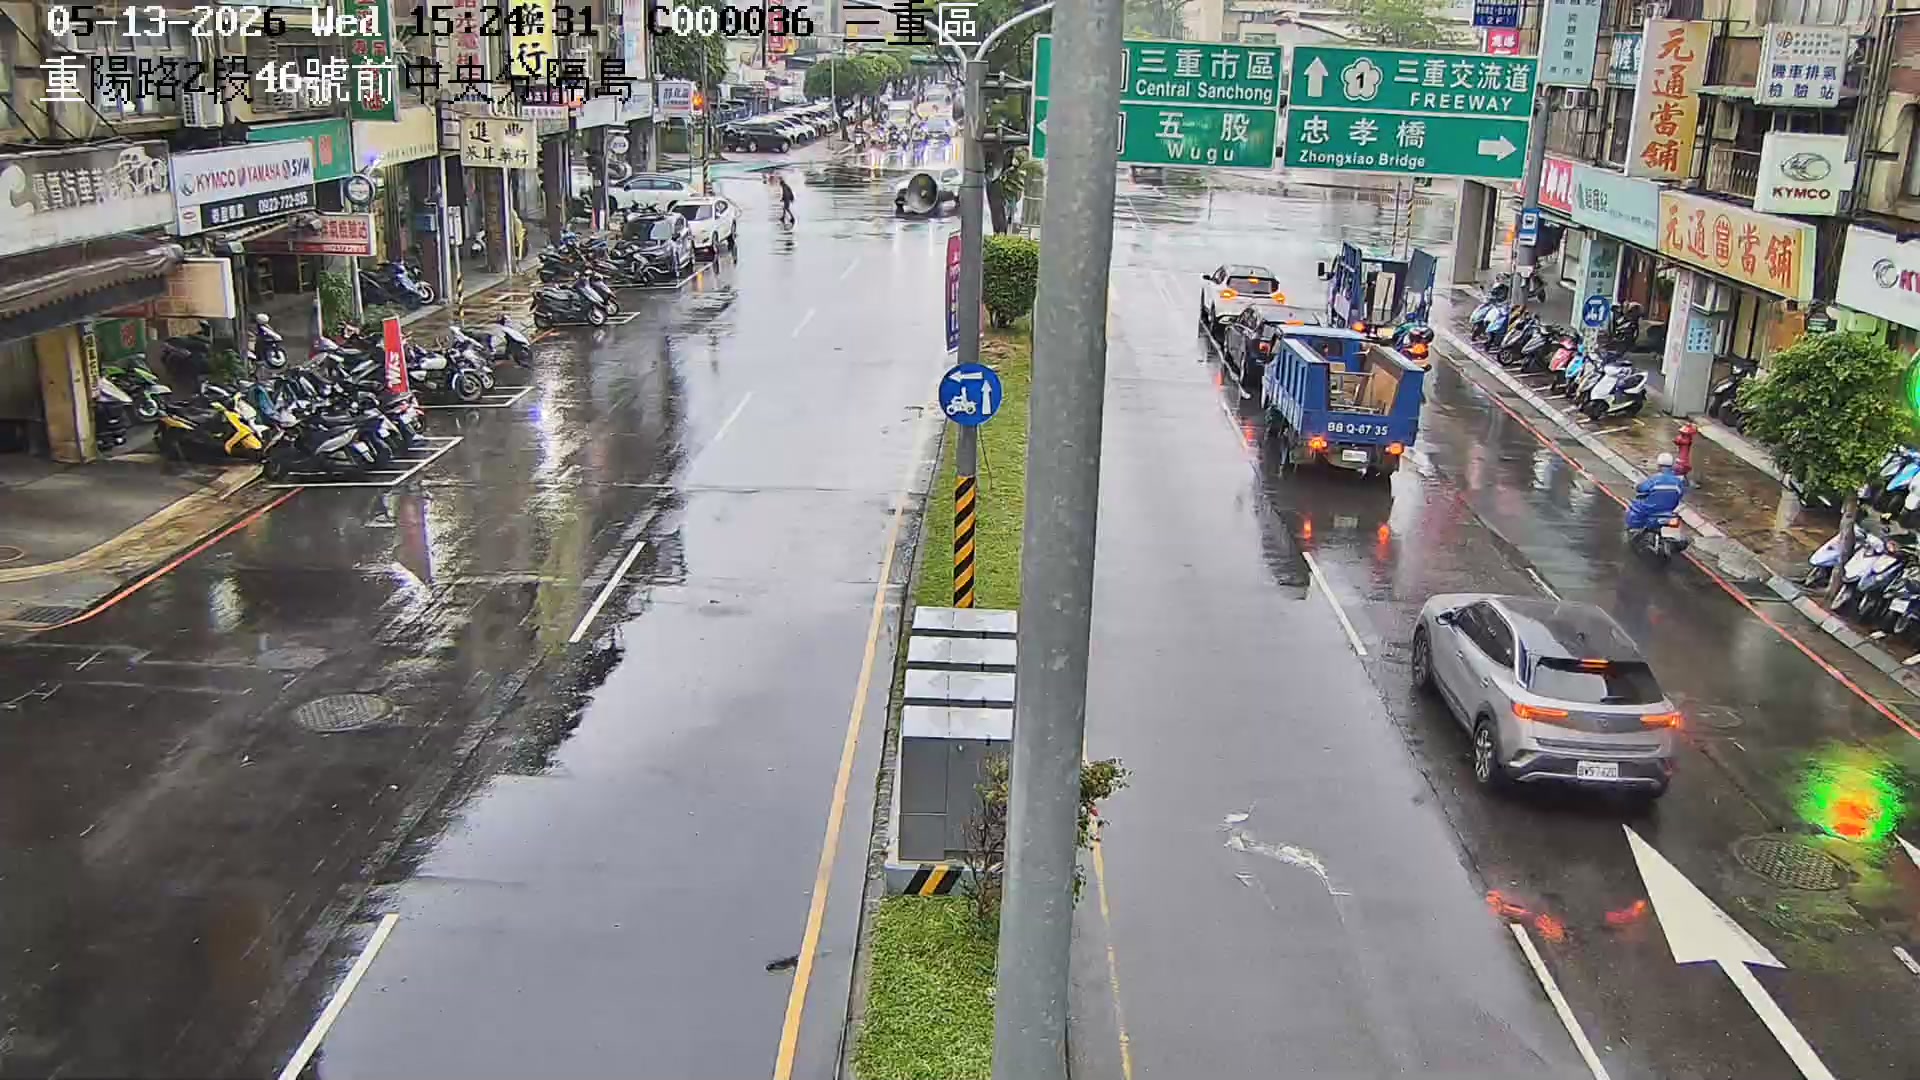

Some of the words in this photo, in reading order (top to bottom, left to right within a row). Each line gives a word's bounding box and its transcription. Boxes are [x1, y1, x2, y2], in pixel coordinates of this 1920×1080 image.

[1136, 48, 1276, 80] 三重市區
[1393, 58, 1530, 93] 三重交流道
[1135, 79, 1191, 97] Central
[1197, 82, 1273, 105] Sanchong
[1354, 72, 1366, 89] 1
[1410, 92, 1513, 112] FREEWAY
[1154, 111, 1250, 143] 五股
[1300, 114, 1426, 149] 忠孝橋
[1166, 142, 1235, 164] Wugu
[1299, 149, 1375, 167] Zhongxiao
[1378, 153, 1426, 170] Bridge
[195, 168, 236, 192] KYMCO
[248, 162, 281, 183] YAMAHA
[292, 157, 311, 177] SYM
[1772, 186, 1832, 200] KYMCO
